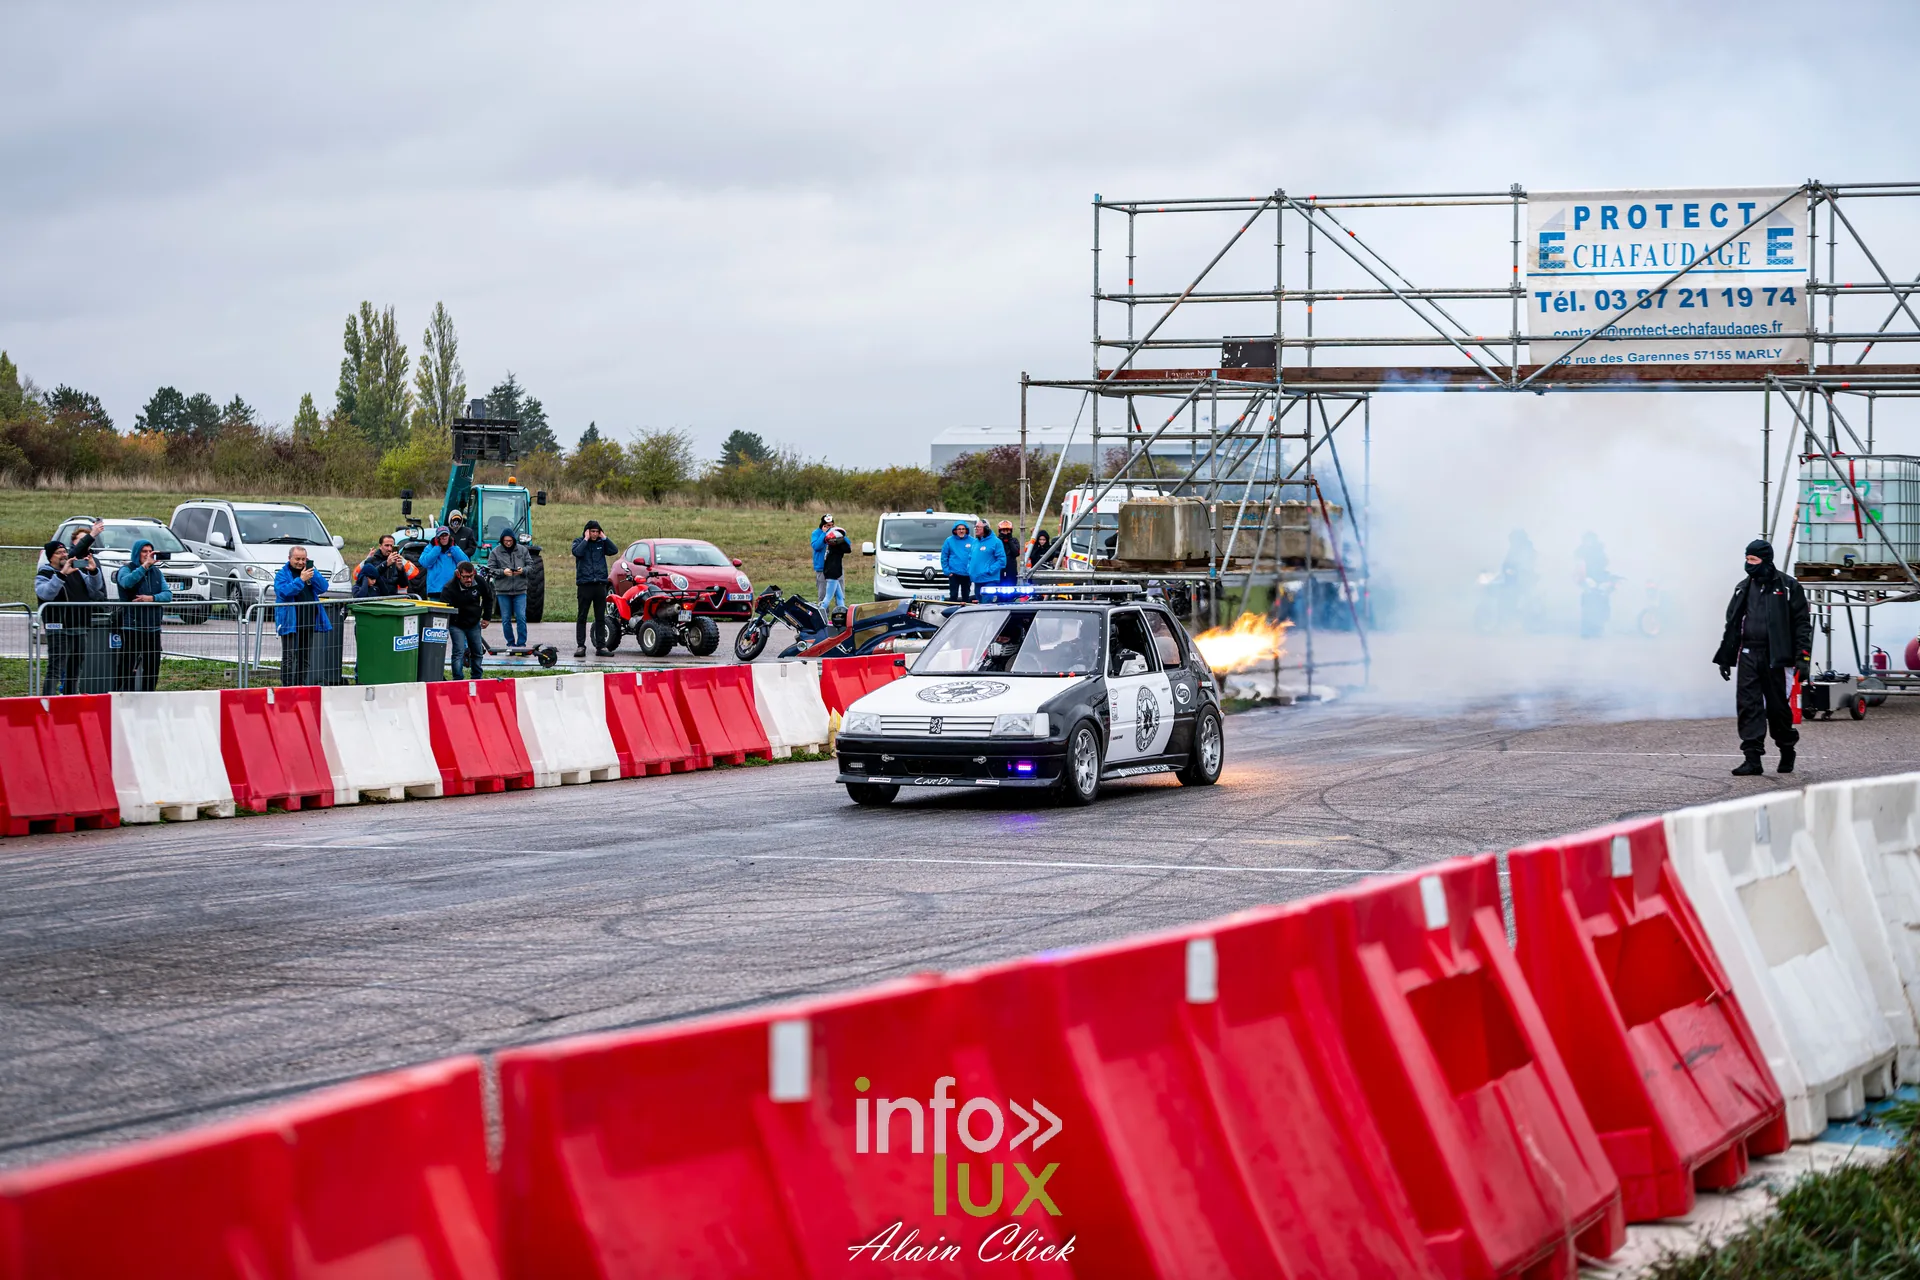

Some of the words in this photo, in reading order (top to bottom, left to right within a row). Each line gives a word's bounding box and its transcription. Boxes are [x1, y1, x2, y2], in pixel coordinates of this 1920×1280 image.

[1574, 202, 1756, 230] PROTECT
[1535, 291, 1586, 313] Tél.
[1594, 289, 1628, 311] 03
[1636, 288, 1668, 310] 87
[1678, 288, 1709, 308] 21
[1721, 287, 1753, 308] 19
[1762, 287, 1797, 306] 74
[1575, 356, 1597, 364] rue
[1600, 354, 1624, 363] des
[1627, 352, 1690, 362] Garennes
[1694, 350, 1732, 360] 57155
[1736, 349, 1782, 359] MARLY
